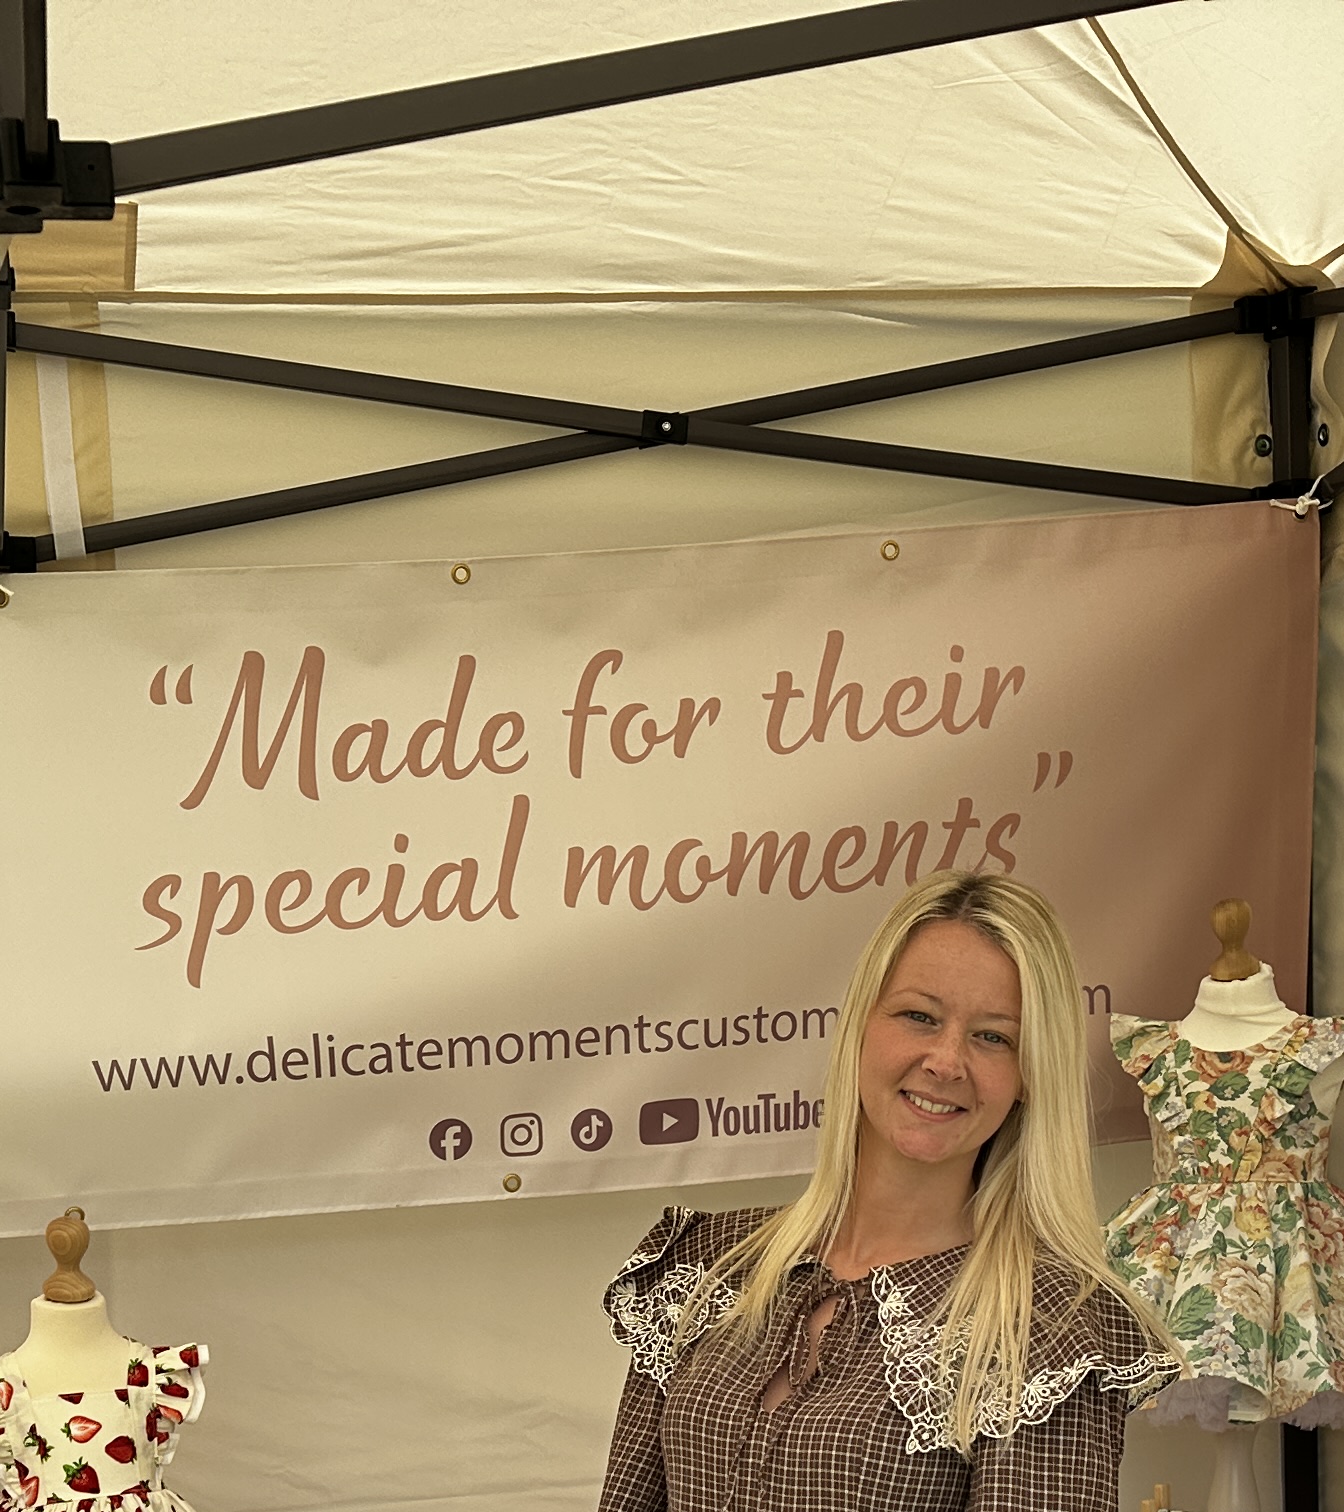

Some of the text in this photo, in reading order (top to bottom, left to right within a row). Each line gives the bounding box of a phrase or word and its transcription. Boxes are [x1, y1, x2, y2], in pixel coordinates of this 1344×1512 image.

[560, 648, 721, 779] for
[761, 629, 1026, 755] their
[135, 794, 532, 989] special
[704, 1089, 825, 1138] YouTube
